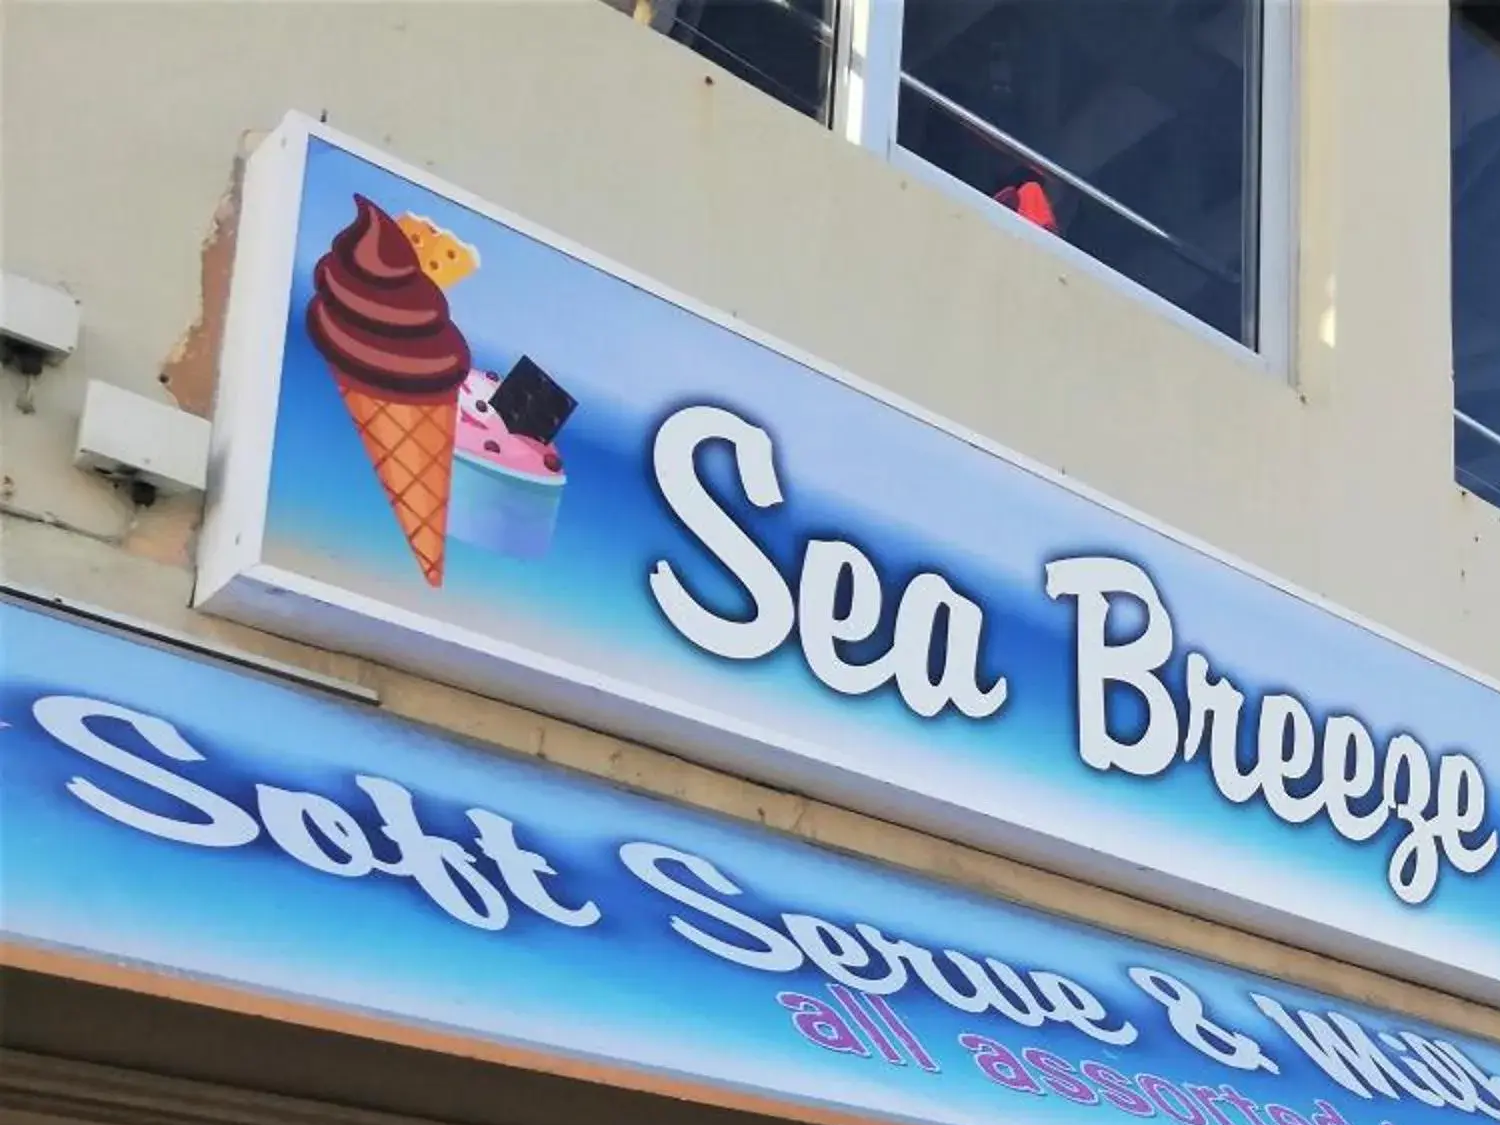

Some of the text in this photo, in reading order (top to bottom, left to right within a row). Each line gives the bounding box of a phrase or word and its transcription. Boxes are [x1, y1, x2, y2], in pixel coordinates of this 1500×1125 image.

[650, 406, 1498, 904] Sea Breeze
[32, 694, 601, 931] Soft
[620, 841, 1137, 1045] Serve
[1129, 966, 1280, 1075] &
[776, 983, 941, 1073] all
